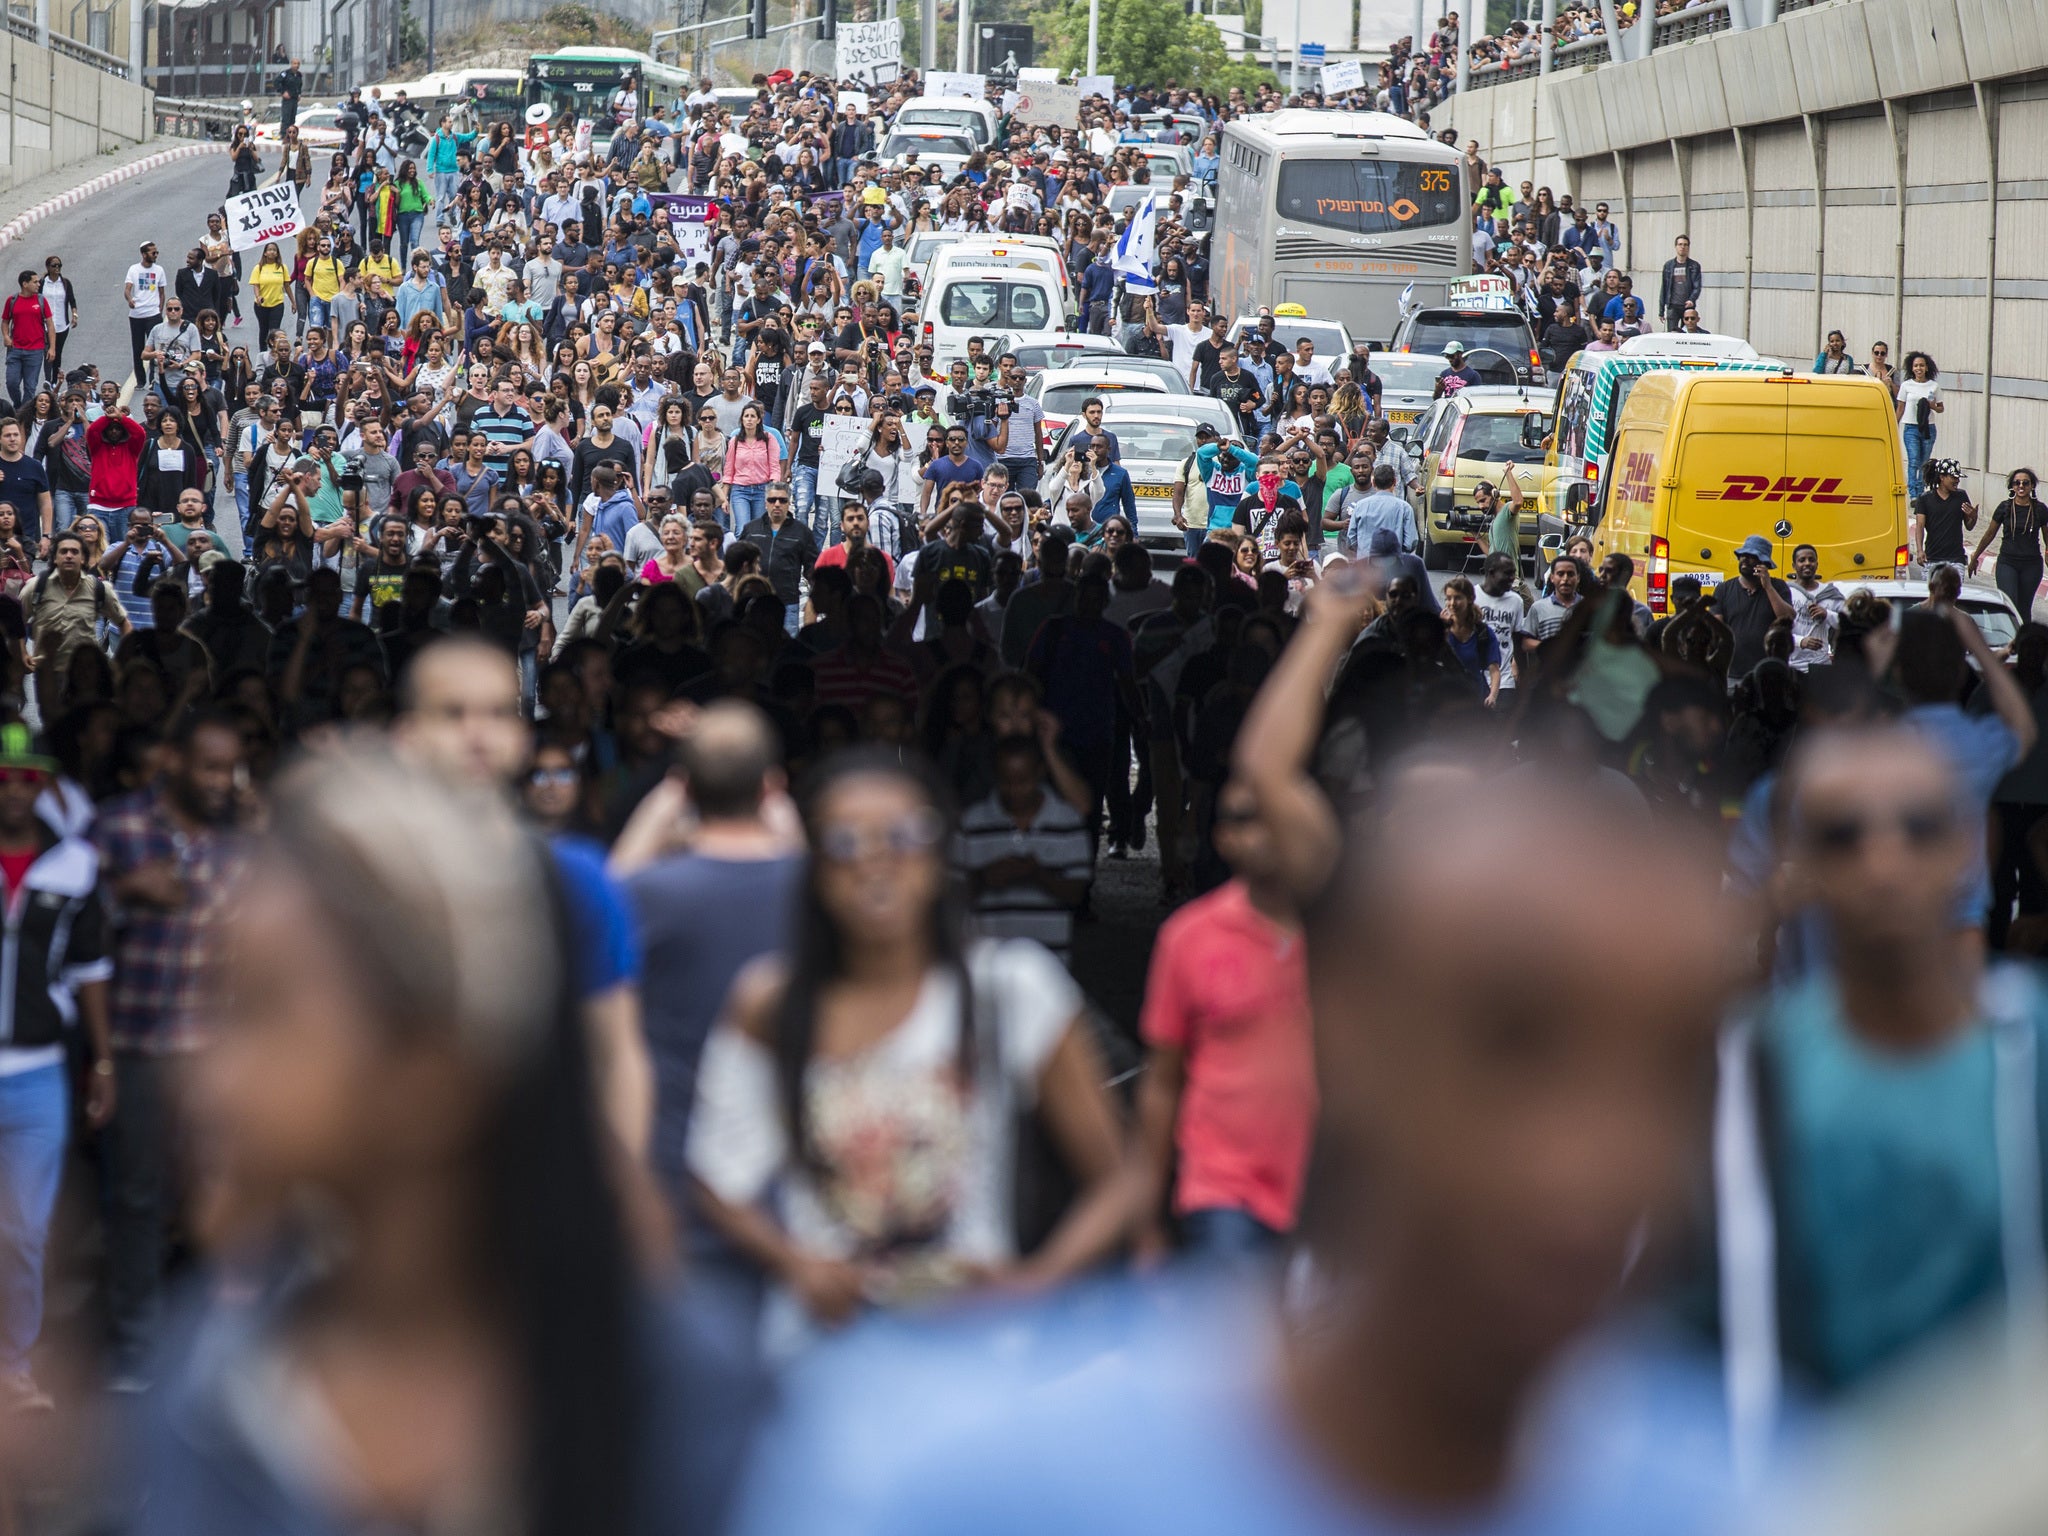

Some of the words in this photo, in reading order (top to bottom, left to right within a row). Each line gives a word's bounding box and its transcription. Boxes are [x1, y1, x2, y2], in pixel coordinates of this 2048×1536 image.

[1420, 171, 1450, 192] 375
[240, 185, 291, 211] שחור
[1316, 198, 1384, 216] מטרופולין
[271, 203, 296, 221] זה
[669, 202, 708, 219] نصرية
[238, 211, 262, 231] לא
[254, 222, 296, 243] פשע
[1350, 237, 1382, 245] MAN
[1326, 261, 1353, 270] 5900
[1480, 278, 1509, 293] אדם
[1211, 474, 1242, 493] ECKO
[1720, 475, 1850, 505] DHL
